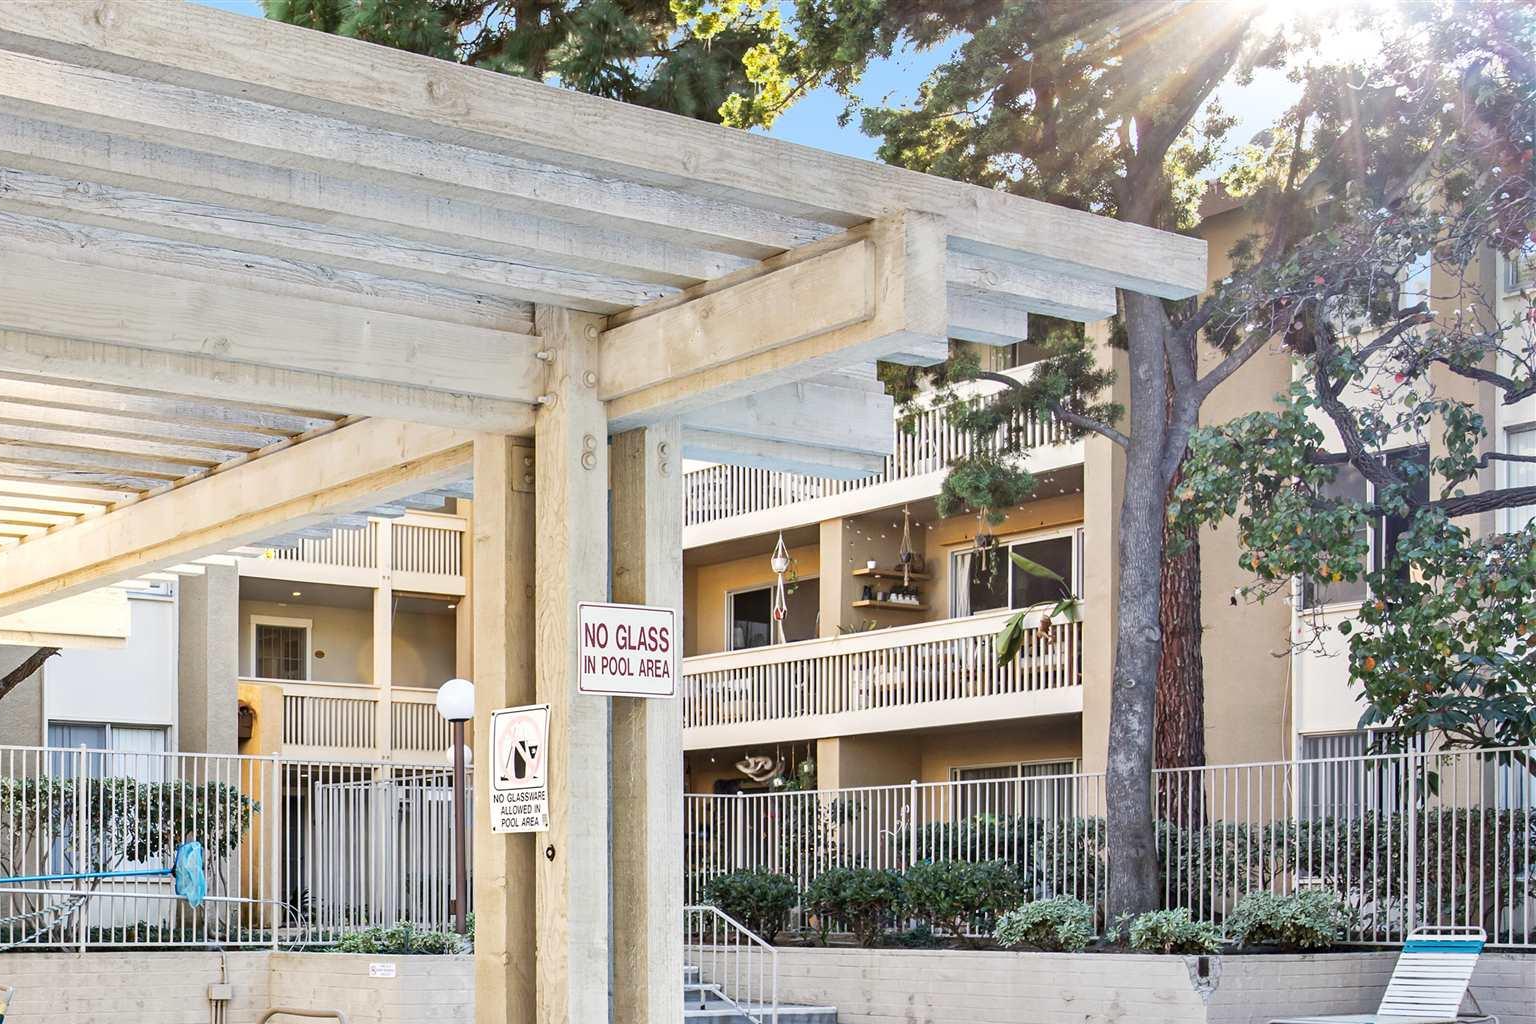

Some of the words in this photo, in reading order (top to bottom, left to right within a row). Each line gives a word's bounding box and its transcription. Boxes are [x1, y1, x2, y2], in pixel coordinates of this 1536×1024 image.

[584, 622, 609, 649] NO
[616, 624, 670, 653] GLASS
[584, 655, 596, 674] IN
[601, 656, 634, 676] POOL
[639, 658, 670, 679] AREA
[493, 793, 505, 804] NO
[507, 791, 545, 803] GLASSWARE
[500, 804, 532, 815] ALLOWED
[534, 803, 541, 813] IN
[501, 818, 519, 828] POOL
[521, 817, 539, 827] AREA
